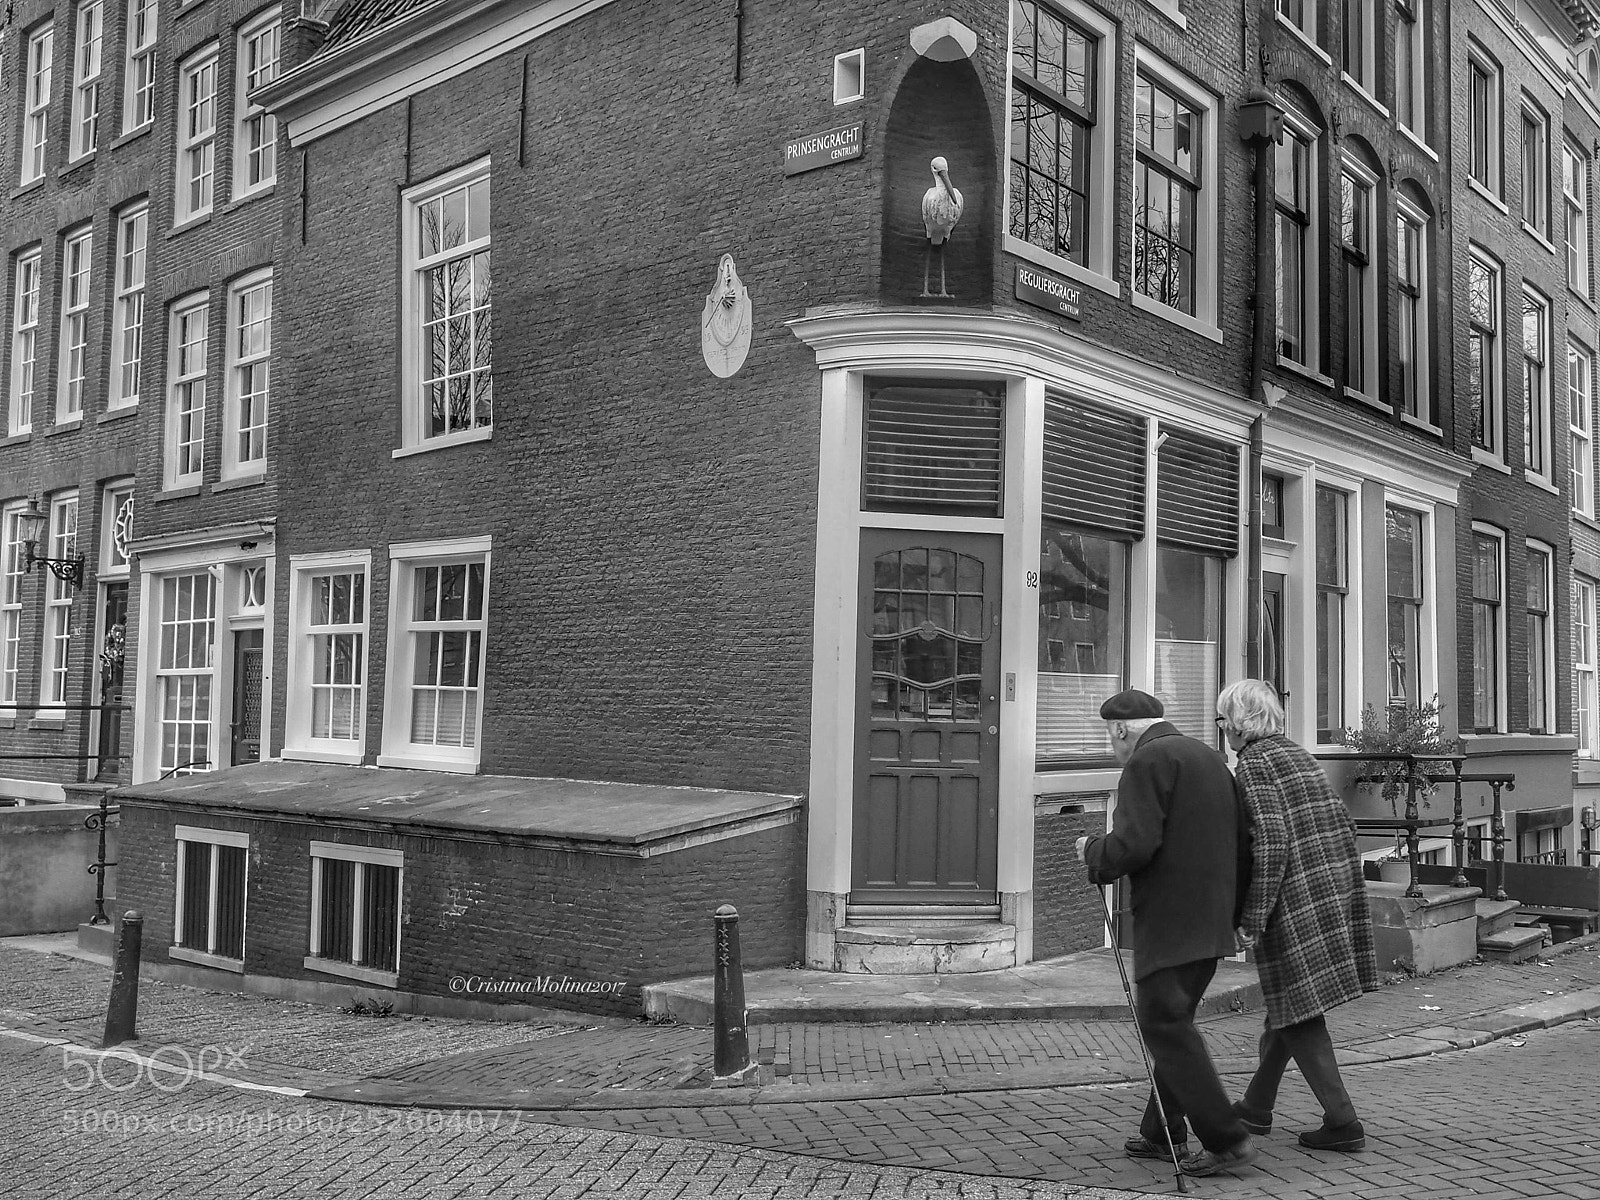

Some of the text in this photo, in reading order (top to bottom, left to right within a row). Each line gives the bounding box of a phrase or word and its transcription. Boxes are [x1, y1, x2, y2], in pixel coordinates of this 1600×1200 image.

[787, 127, 859, 160] PRINSENGRACHT
[830, 144, 859, 160] CENTRUM
[1019, 269, 1080, 304] REGULIERSGRACHT
[1059, 301, 1079, 316] CENTRUM
[1026, 570, 1037, 588] 92
